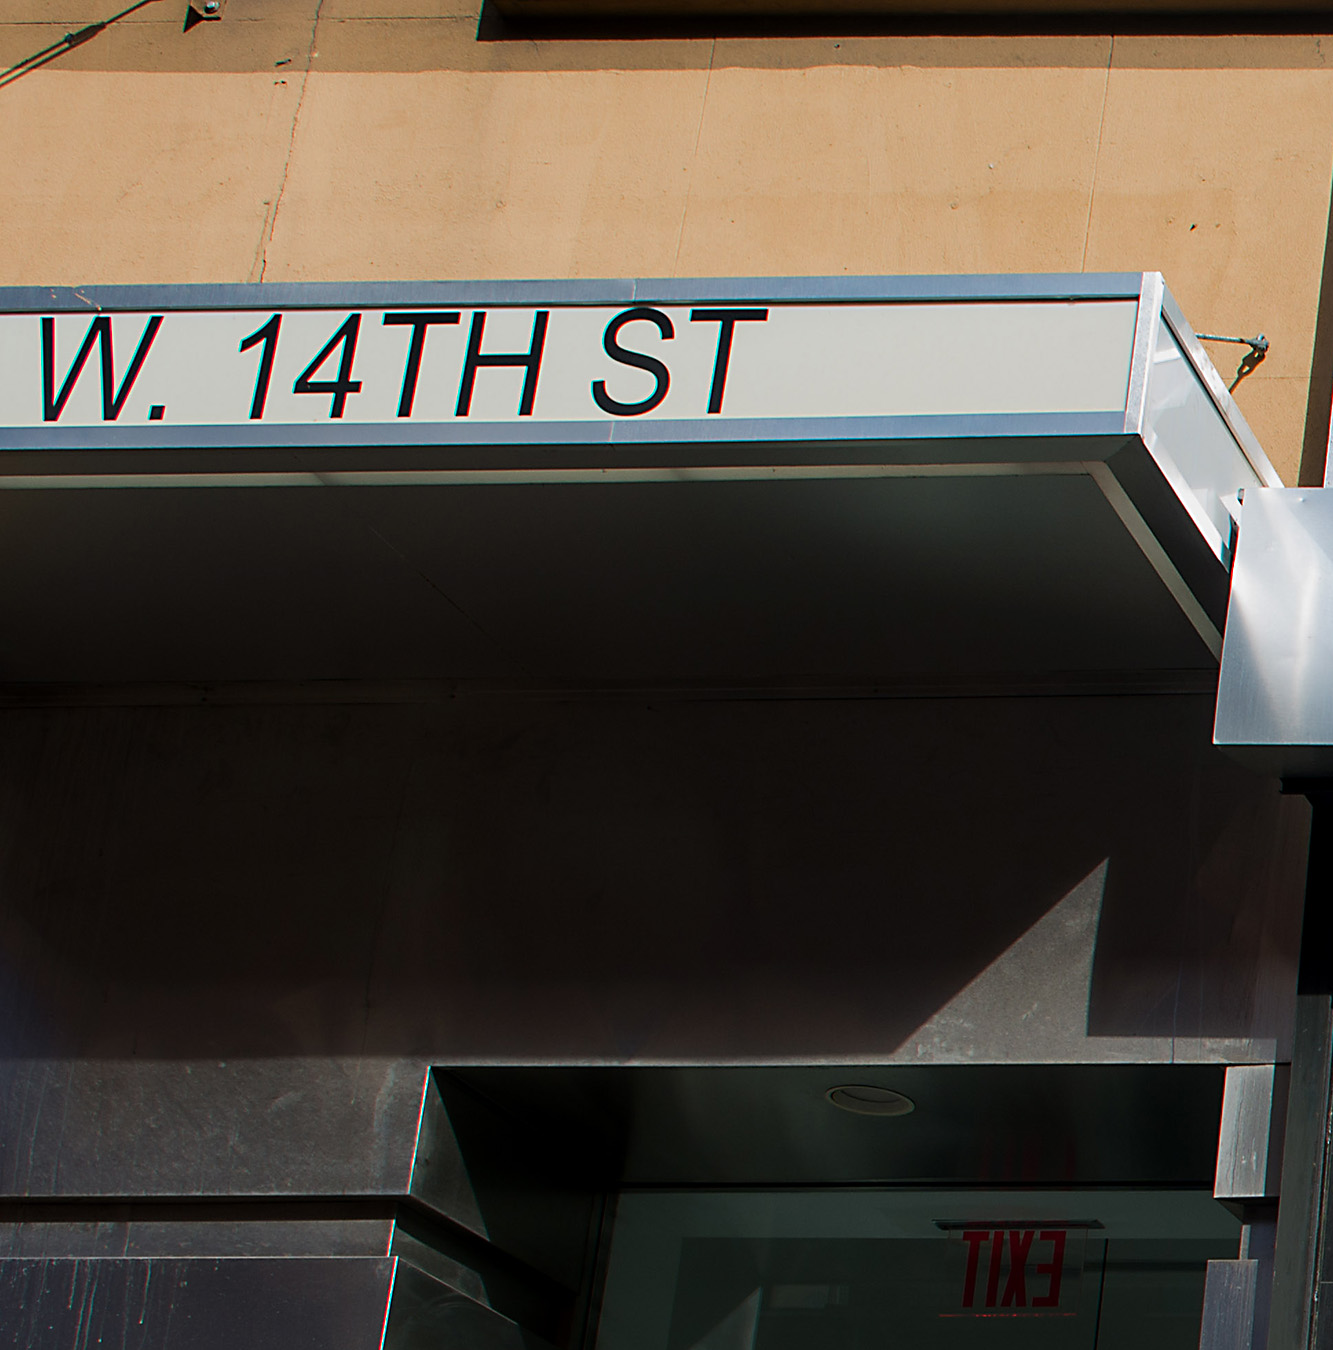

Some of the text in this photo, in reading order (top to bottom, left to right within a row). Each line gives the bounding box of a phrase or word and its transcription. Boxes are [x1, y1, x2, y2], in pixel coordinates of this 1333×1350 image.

[39, 306, 769, 422] W. 14TH ST
